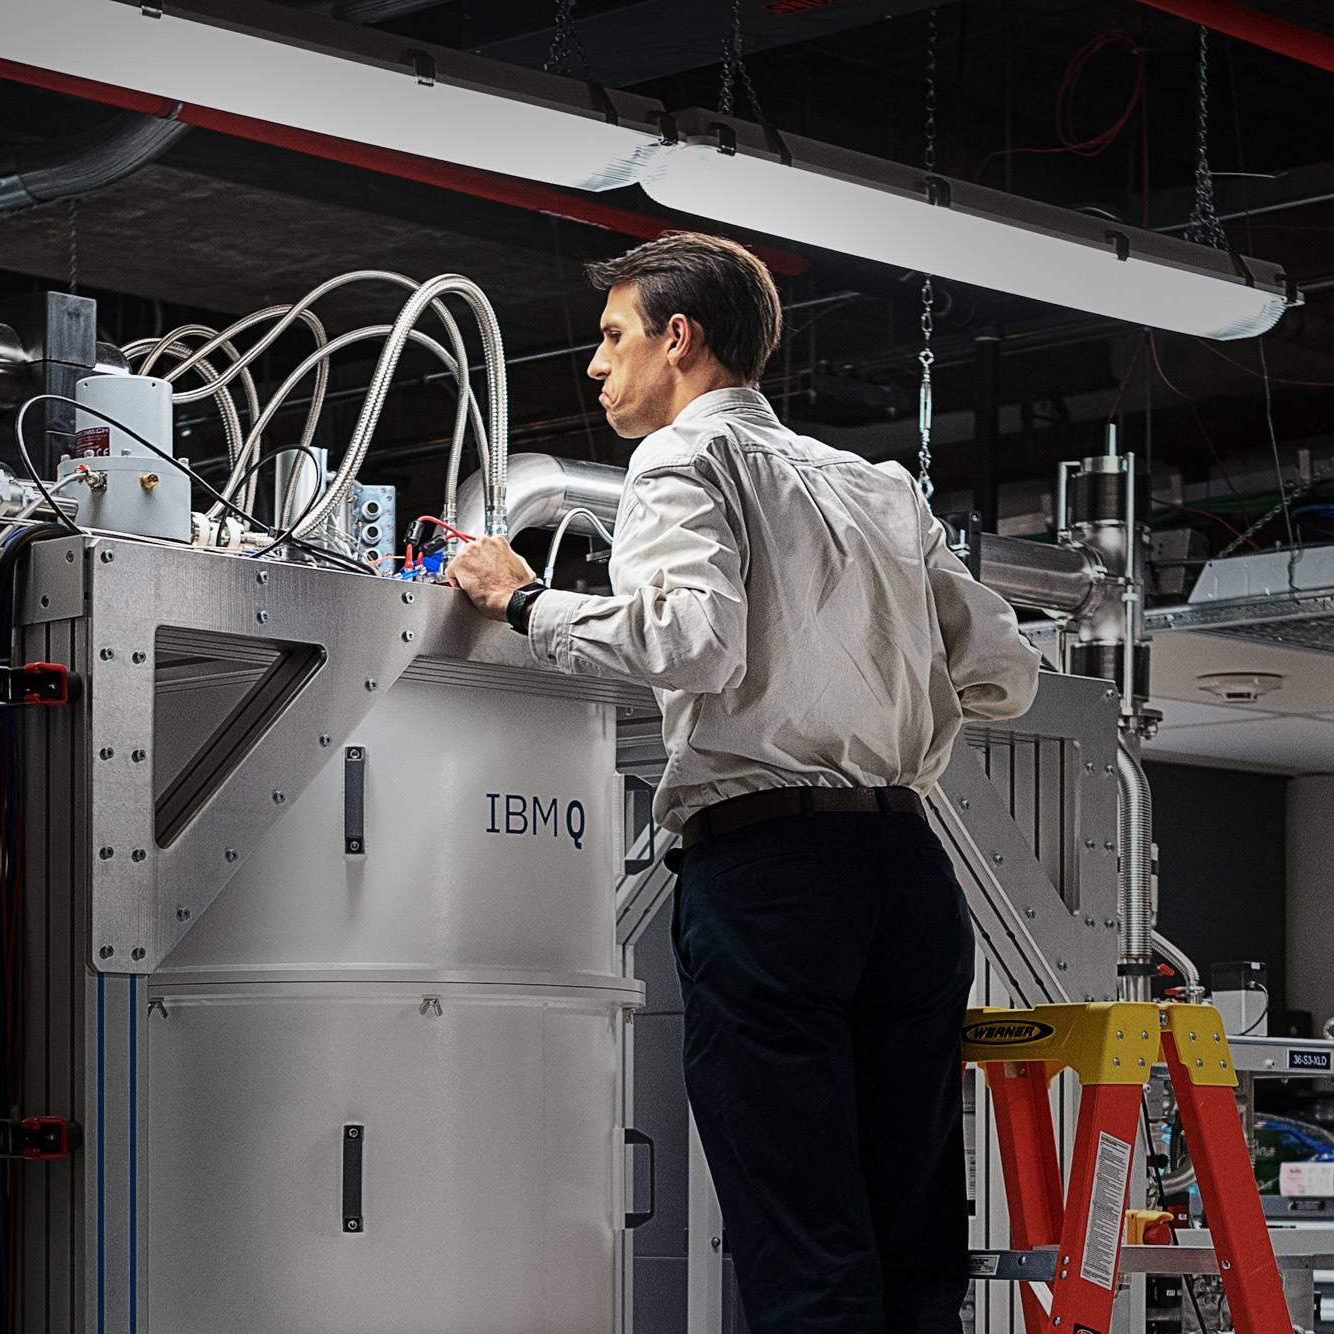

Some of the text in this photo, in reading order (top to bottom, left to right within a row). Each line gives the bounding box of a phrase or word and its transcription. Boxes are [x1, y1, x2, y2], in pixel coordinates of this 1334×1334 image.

[486, 793, 585, 849] IBM Q
[974, 1026, 1035, 1039] WERNER
[1293, 1054, 1327, 1066] 36-S3-XLD
